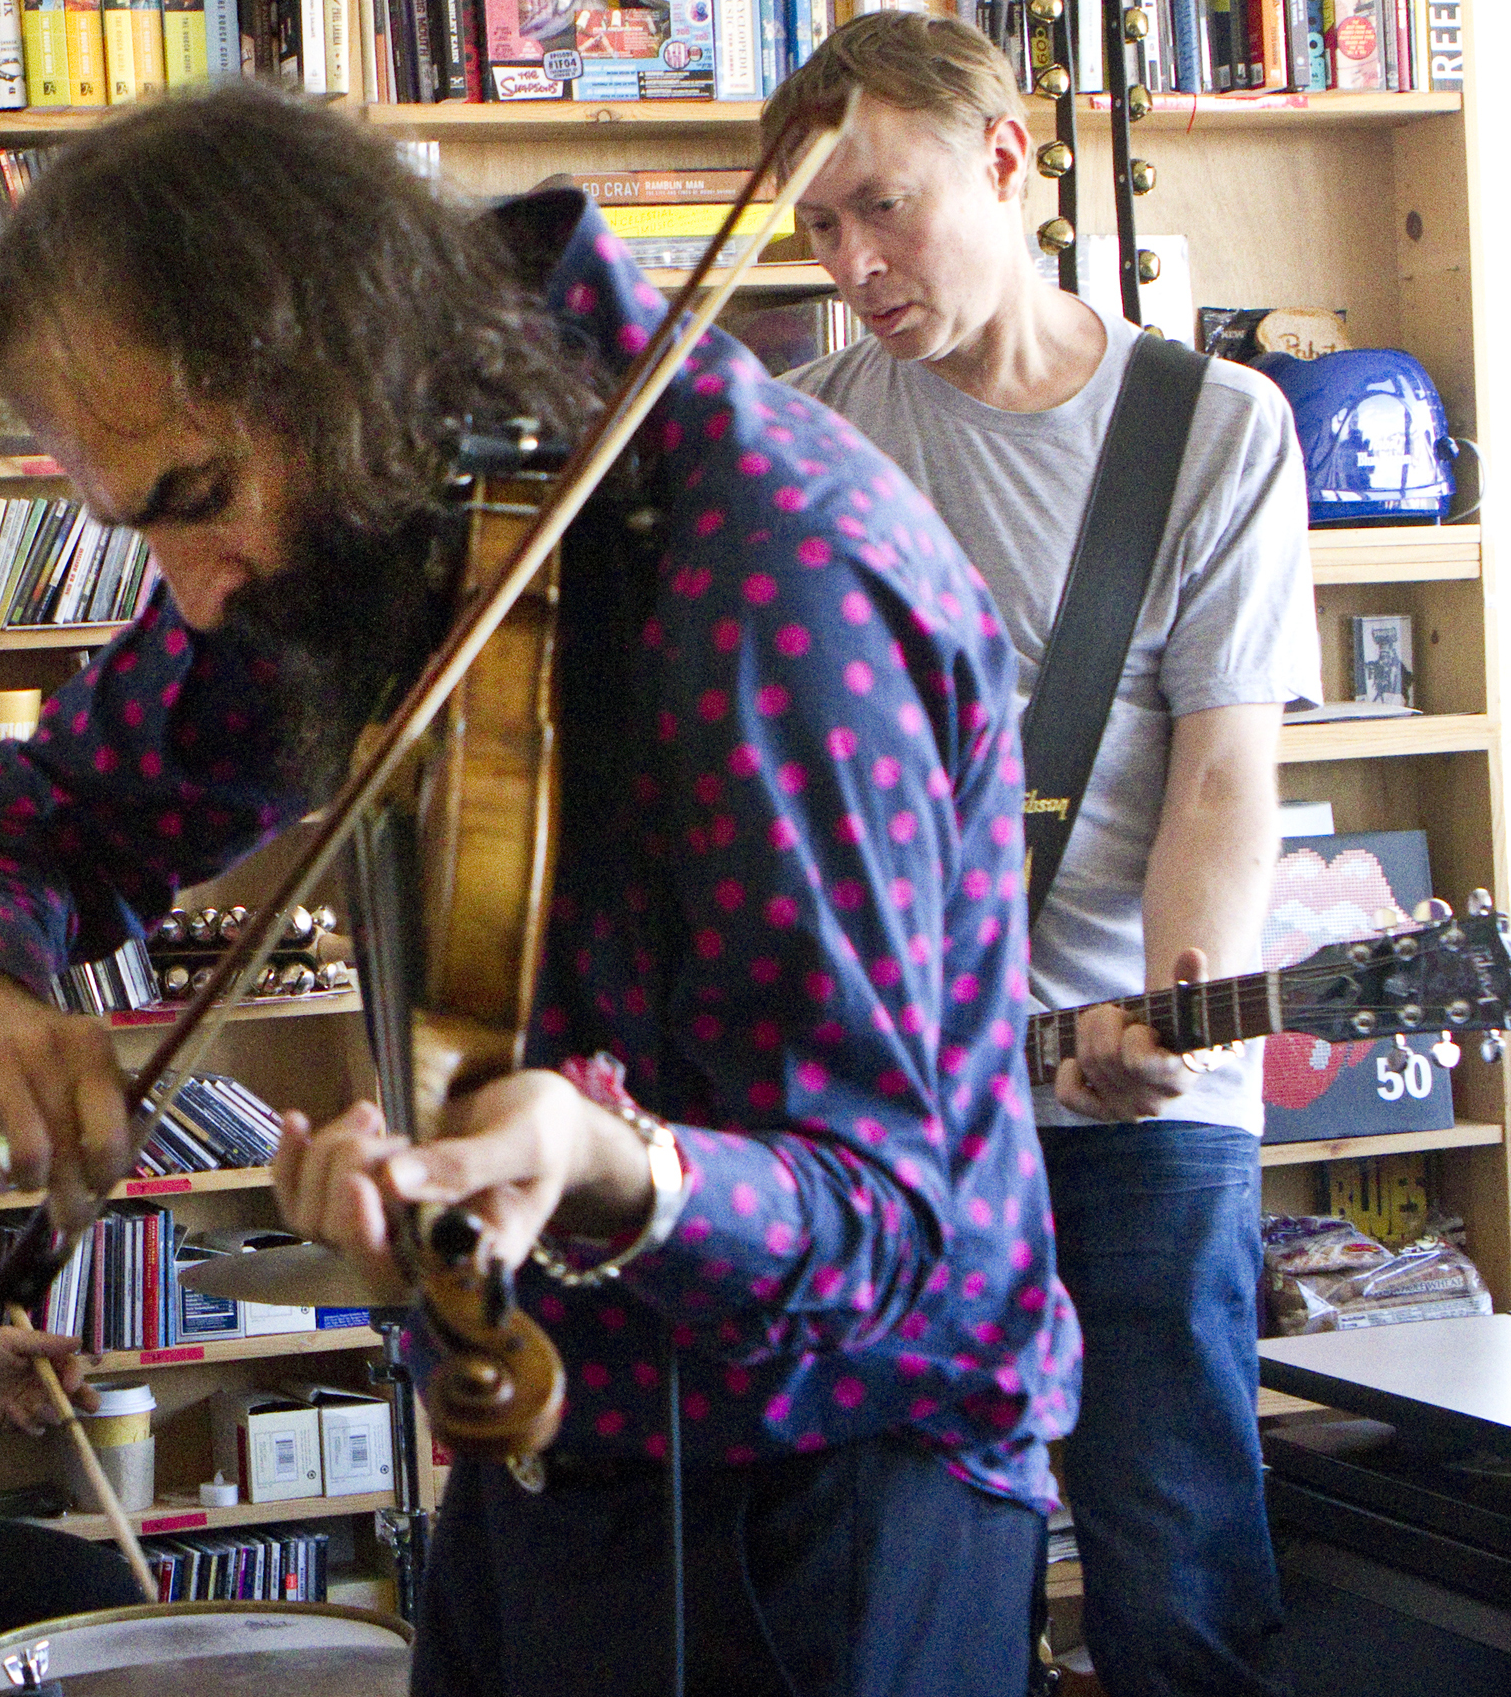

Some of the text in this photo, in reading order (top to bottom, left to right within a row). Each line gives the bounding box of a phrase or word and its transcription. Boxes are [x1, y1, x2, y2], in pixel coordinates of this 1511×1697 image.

[218, 14, 227, 44] ROUGH
[418, 18, 429, 57] MOUTH
[1429, 0, 1464, 79] REE
[450, 34, 460, 64] KAHN
[548, 59, 577, 71] #1F04
[605, 182, 640, 197] CRAY
[685, 180, 704, 189] MAN
[620, 210, 674, 227] CELESTIAL
[640, 220, 674, 234] MUSIC
[1376, 1054, 1433, 1102] 50
[1427, 1275, 1464, 1292] WHEAT
